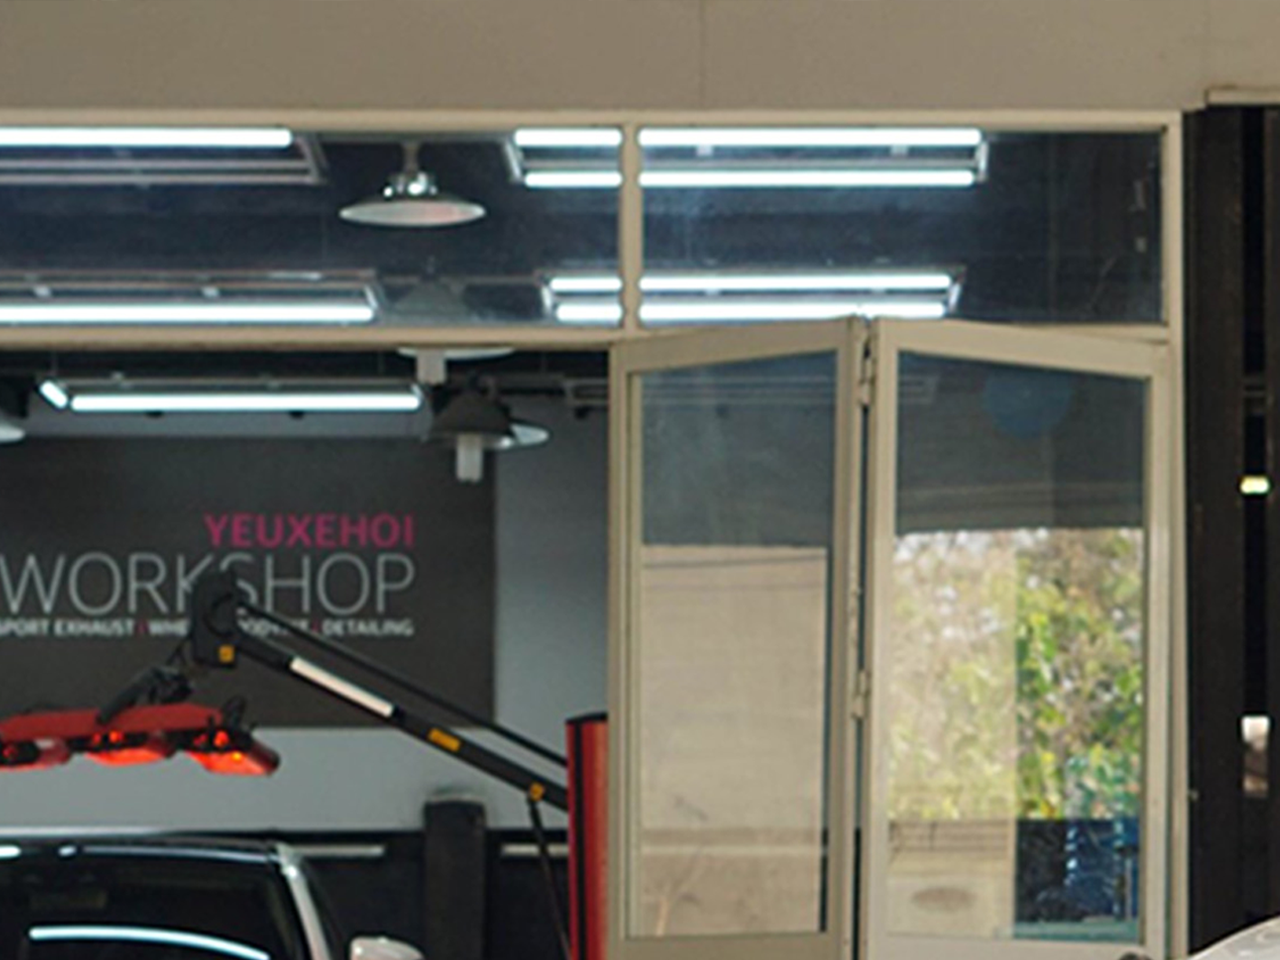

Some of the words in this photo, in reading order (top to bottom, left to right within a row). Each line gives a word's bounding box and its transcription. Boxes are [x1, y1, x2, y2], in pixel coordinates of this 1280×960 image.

[204, 515, 416, 547] YEUXEHOI
[53, 617, 134, 637] EXHAUST
[322, 618, 415, 637] DETAILING
